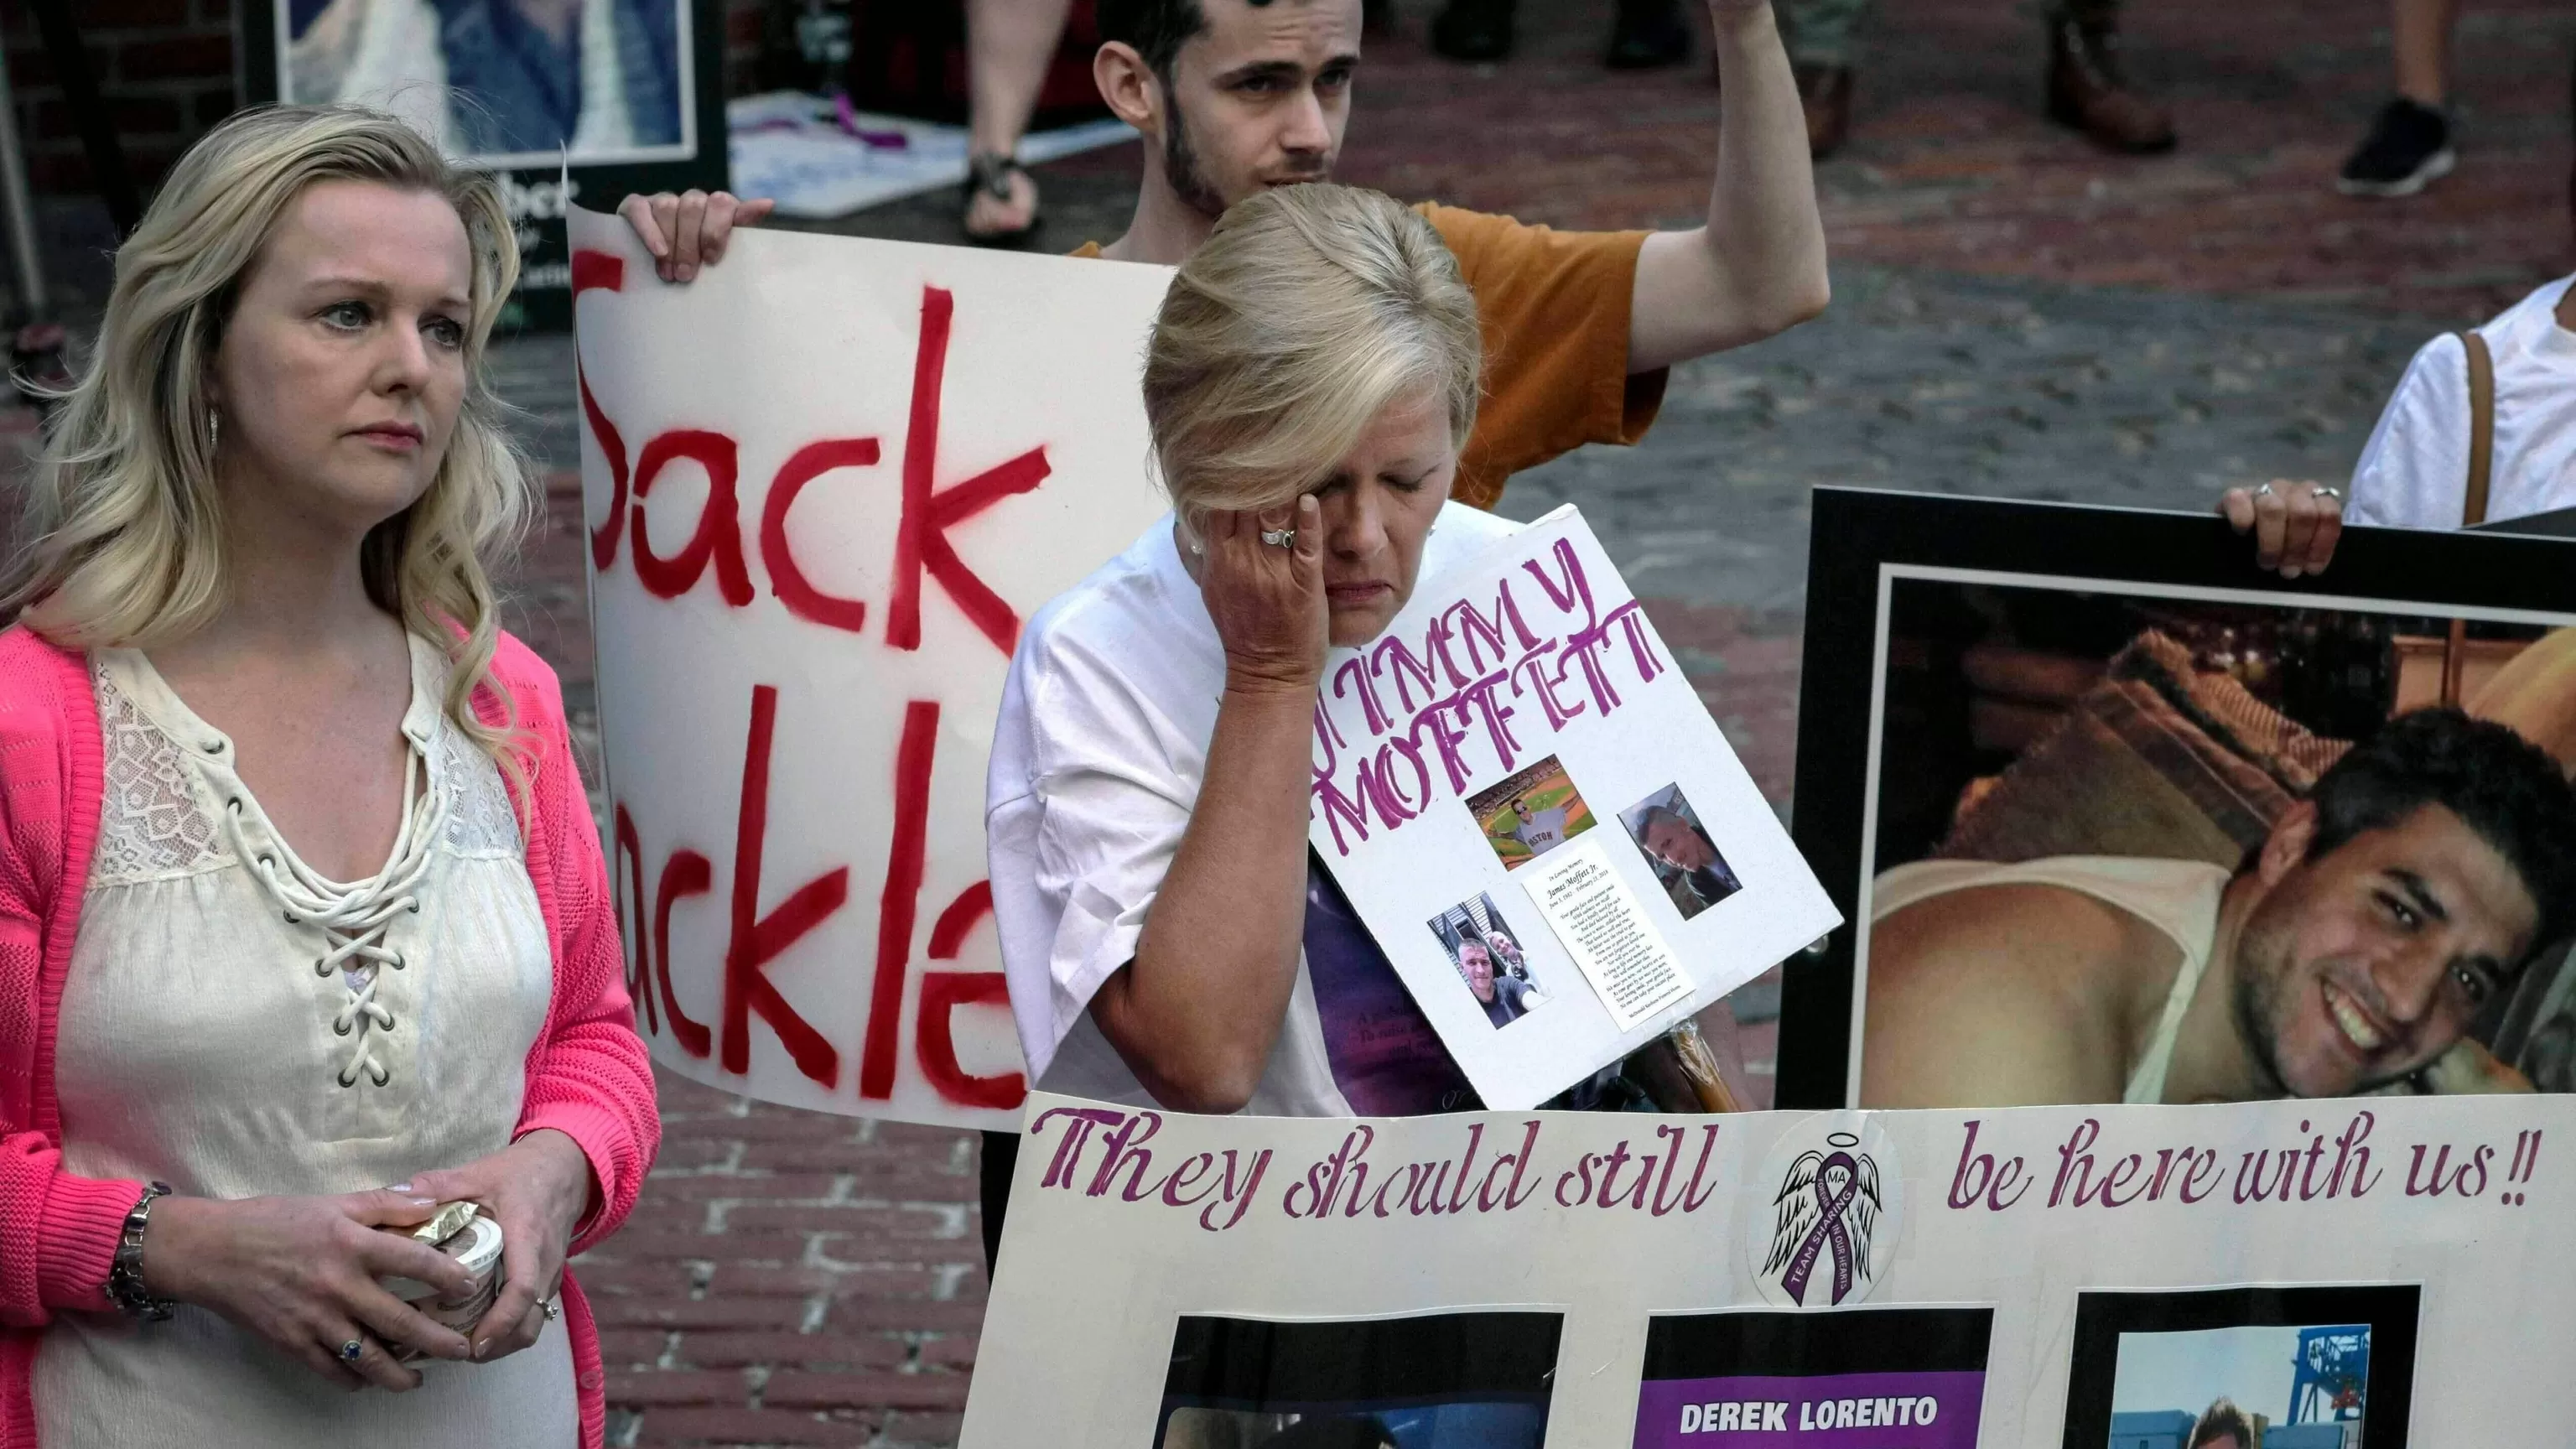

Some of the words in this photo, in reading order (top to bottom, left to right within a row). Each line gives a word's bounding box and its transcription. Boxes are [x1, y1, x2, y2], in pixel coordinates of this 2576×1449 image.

[1312, 538, 1597, 780] JIMMY
[1311, 599, 1665, 857] MOFFETT
[1547, 884, 1566, 899] James
[1566, 869, 1589, 886] Moffett
[1589, 865, 1598, 874] Jr.
[1031, 1107, 1274, 1232] They
[1284, 1119, 1542, 1219] should
[1555, 1124, 1720, 1217] still
[1947, 1120, 2034, 1212] be
[2047, 1118, 2225, 1209] here
[2232, 1110, 2384, 1205] with
[1828, 1171, 1846, 1184] MA
[1818, 1178, 1831, 1208] FOREVER
[1790, 1247, 1816, 1285] TEAM
[1812, 1189, 1853, 1245] SHARING
[1831, 1223, 1841, 1235] IN
[1834, 1235, 1846, 1259] OUR
[1838, 1255, 1849, 1291] HEARTS
[1680, 1402, 1789, 1434] DEREK
[1800, 1396, 1938, 1431] LORENTO
